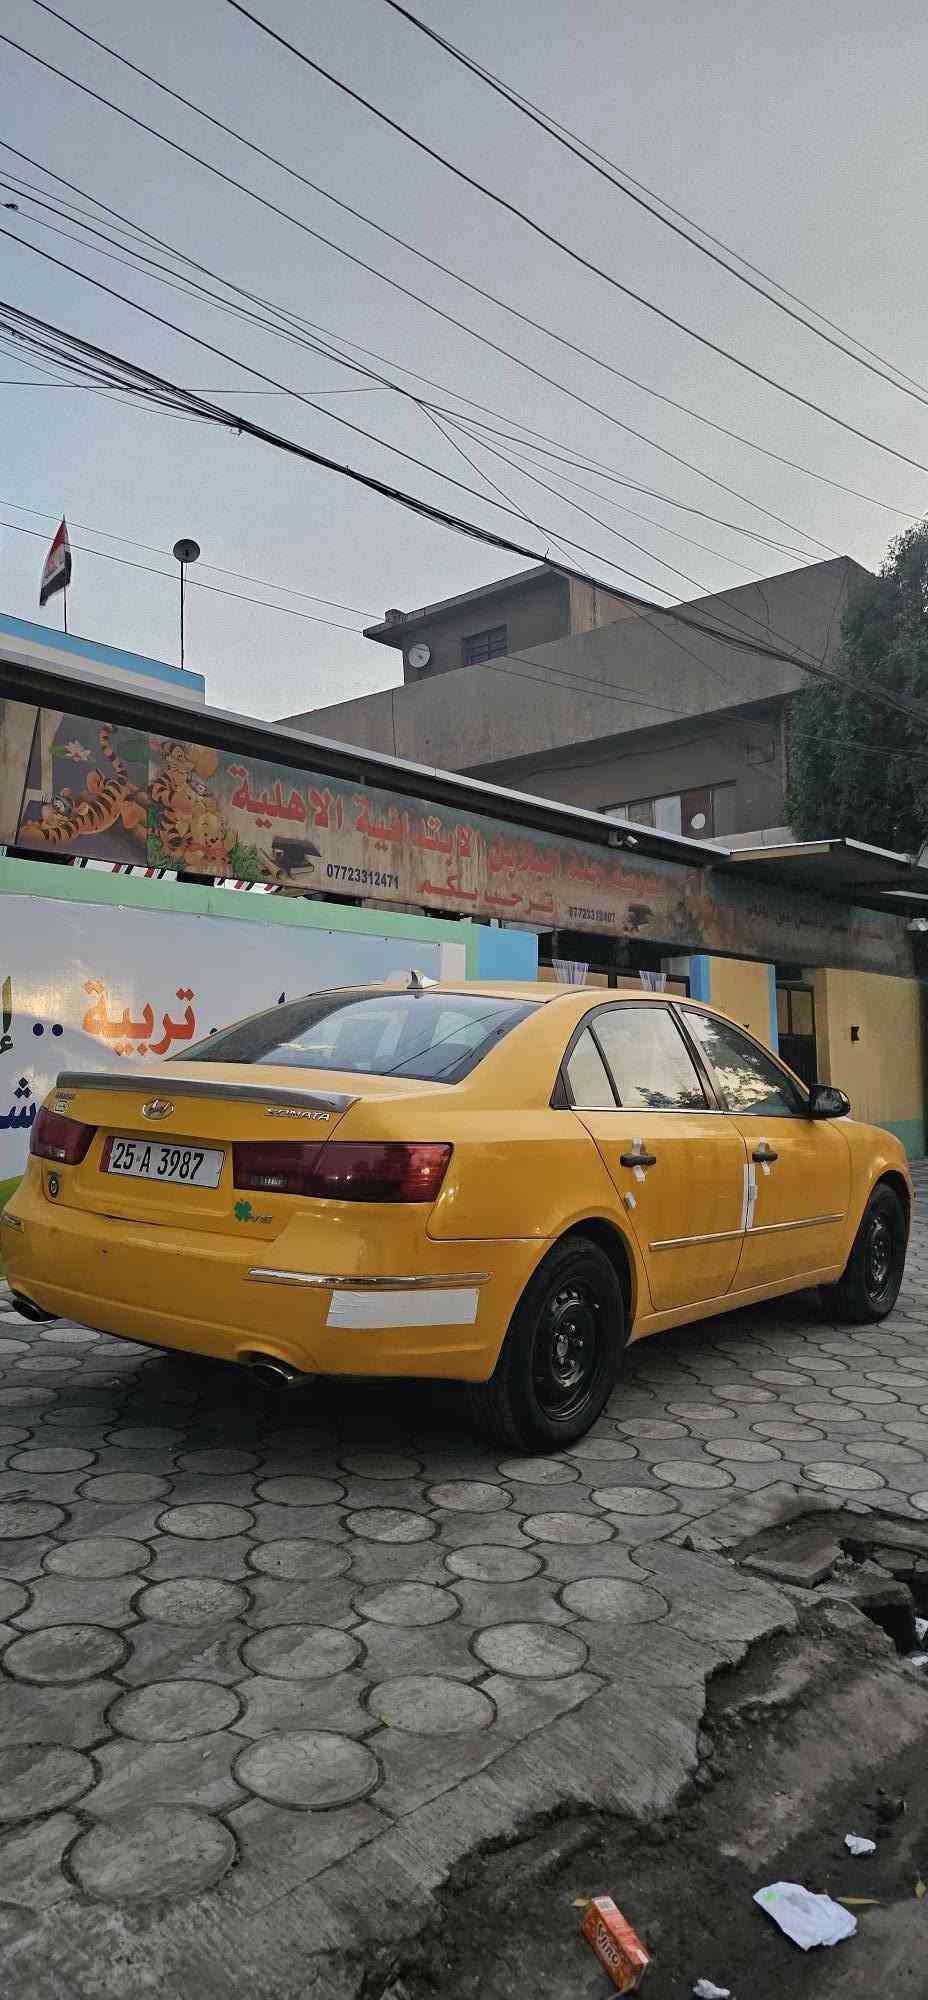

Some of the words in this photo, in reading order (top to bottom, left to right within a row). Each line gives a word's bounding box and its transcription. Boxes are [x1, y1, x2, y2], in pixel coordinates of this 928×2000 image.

[228, 763, 344, 830] الاهلية
[327, 863, 399, 888] 07723312471
[82, 980, 195, 1056] تربية
[264, 1103, 330, 1121] SONATA
[113, 1143, 136, 1170] 25
[140, 1146, 151, 1173] A
[157, 1148, 204, 1180] 3987
